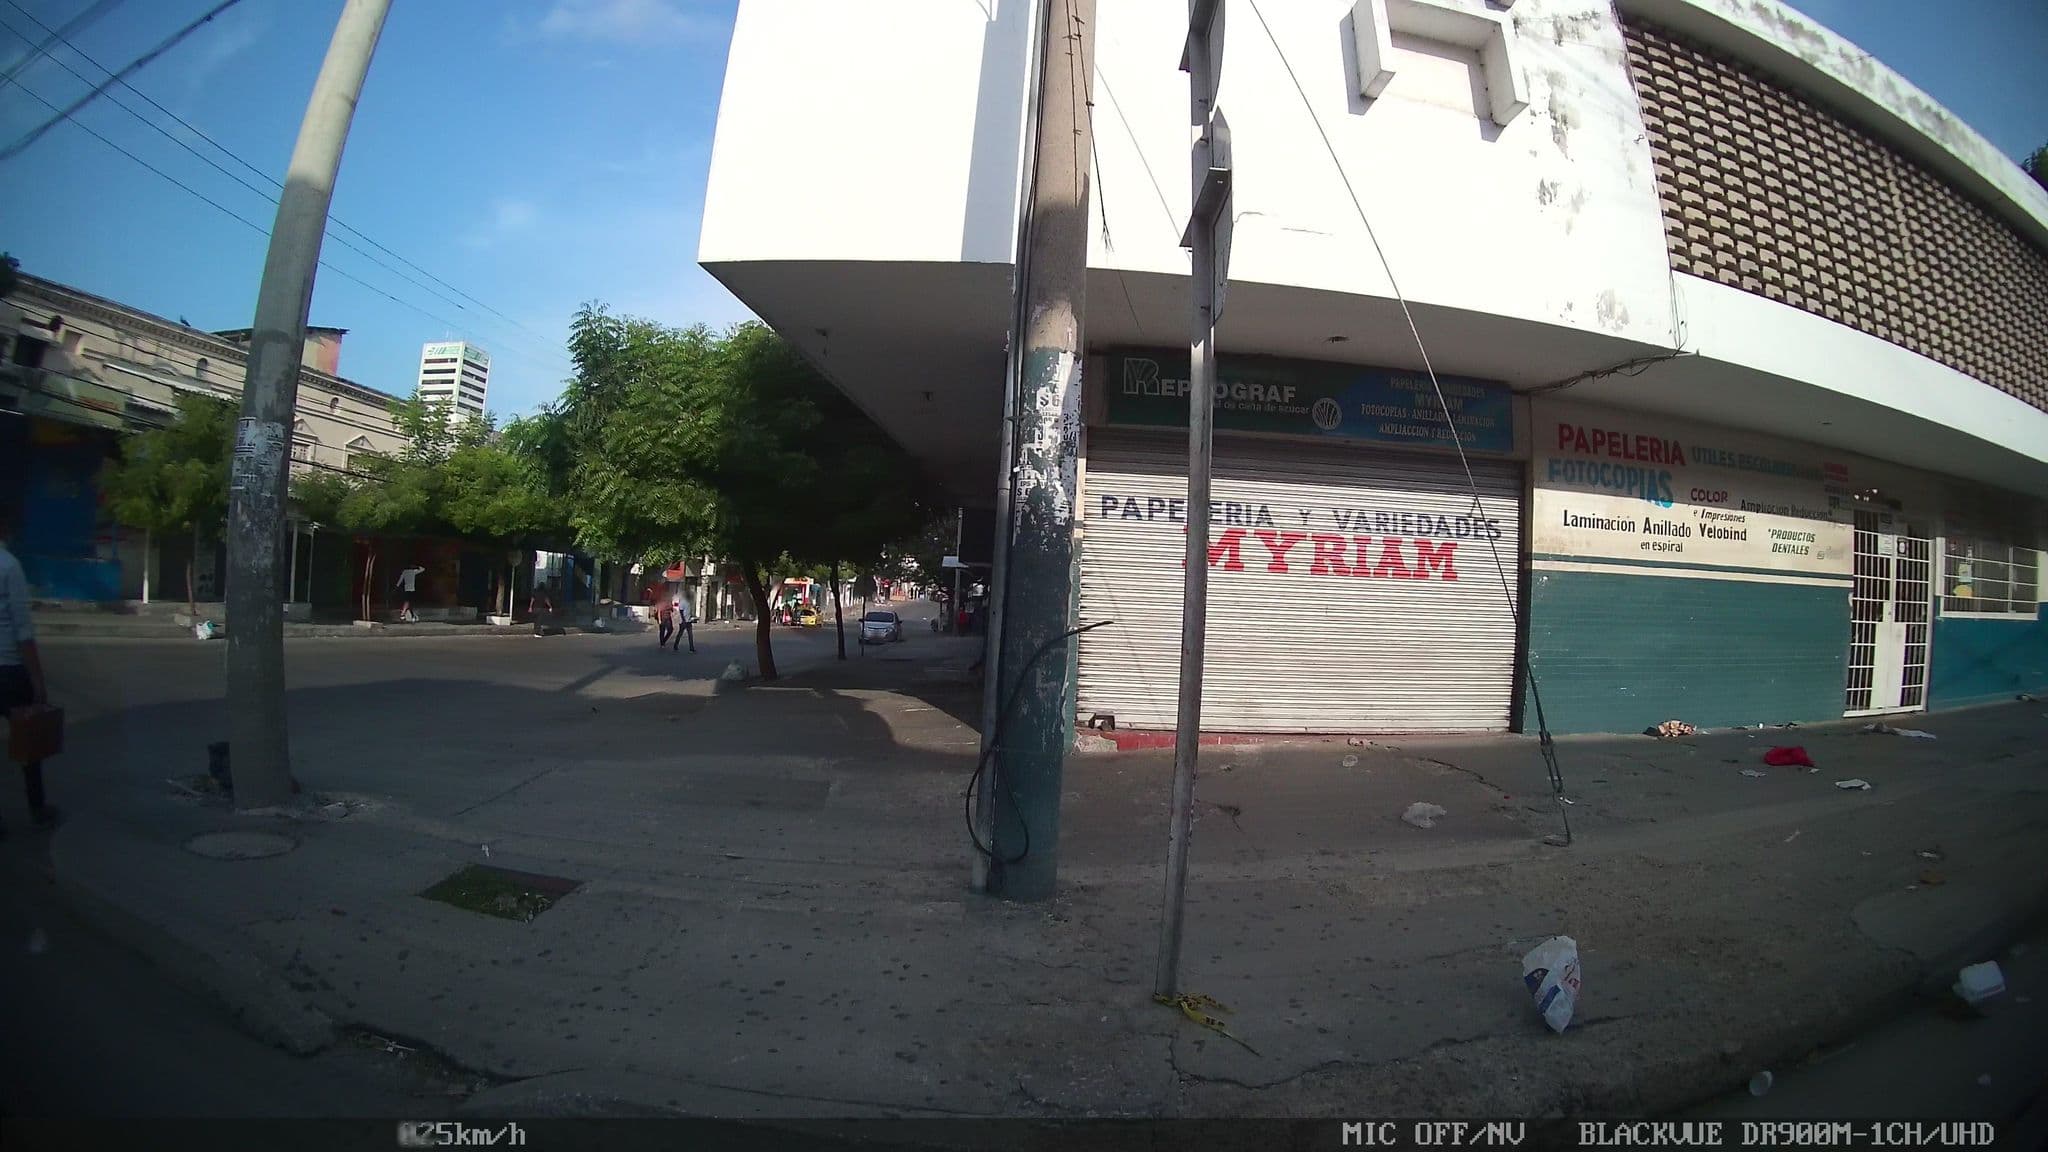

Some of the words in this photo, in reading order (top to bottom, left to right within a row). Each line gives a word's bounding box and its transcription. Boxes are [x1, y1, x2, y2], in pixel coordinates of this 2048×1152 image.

[1122, 357, 1296, 403] REPOGRAF
[1558, 422, 1687, 466] PAPELERIA
[1547, 458, 1674, 508] FOTOCOPIAS
[1691, 488, 1728, 503] COLOR
[1101, 494, 1275, 527] PAPEERIA
[1299, 508, 1312, 526] Y
[1331, 509, 1502, 540] VARIEDADES
[1643, 517, 1692, 538] Anillado
[1699, 522, 1747, 541] Velobind
[1182, 527, 1458, 581] MYRIAM
[1640, 541, 1650, 550] en
[1652, 540, 1683, 552] espiral
[1771, 542, 1810, 556] DENTALES
